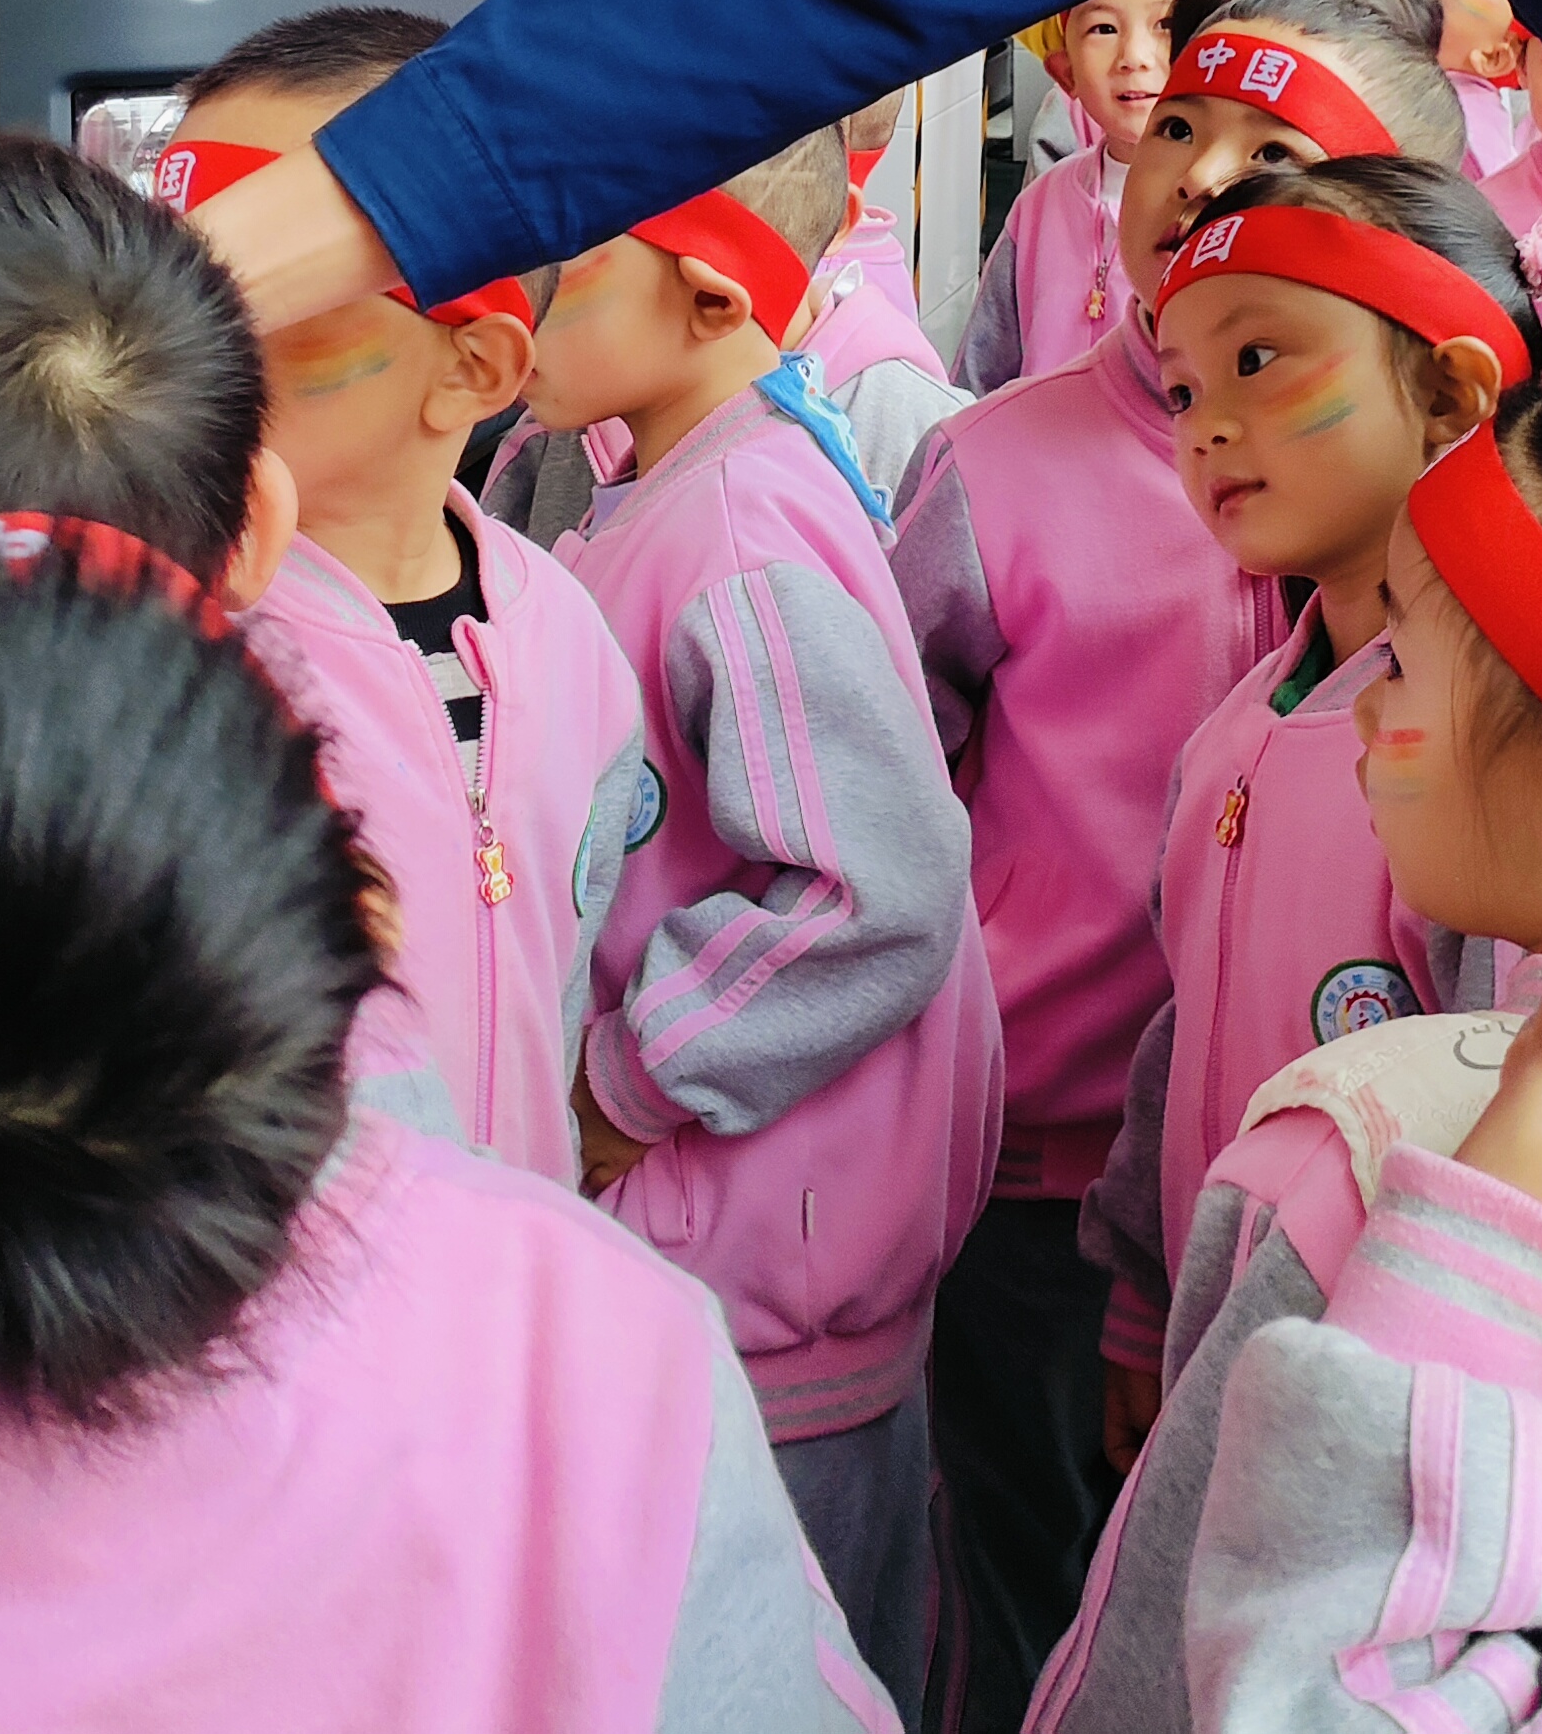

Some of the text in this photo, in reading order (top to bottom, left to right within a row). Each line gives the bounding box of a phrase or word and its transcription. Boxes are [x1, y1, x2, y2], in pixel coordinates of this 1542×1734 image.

[1197, 38, 1298, 102] 中国
[160, 150, 197, 215] 国
[1161, 215, 1246, 287] 国
